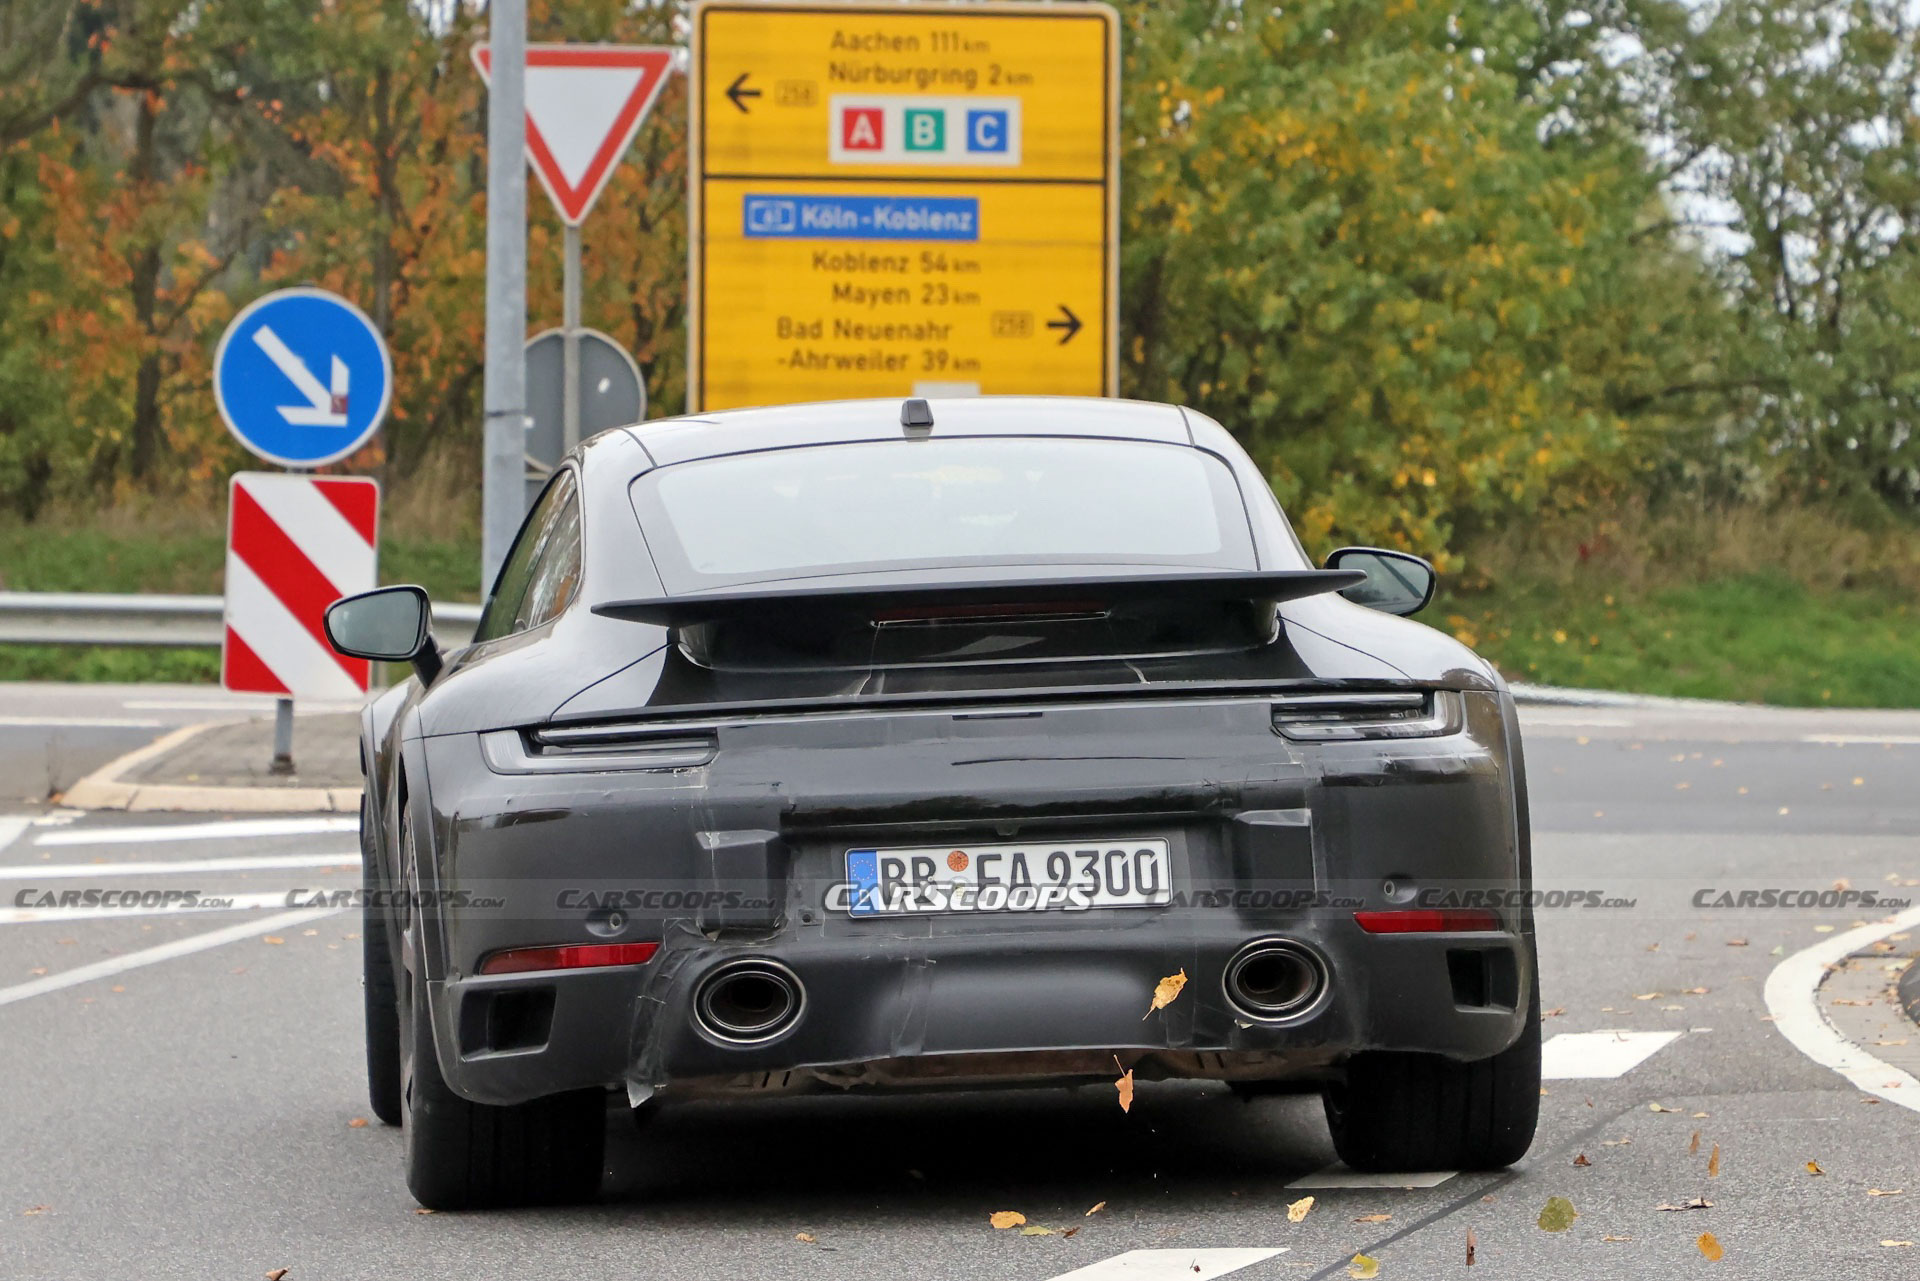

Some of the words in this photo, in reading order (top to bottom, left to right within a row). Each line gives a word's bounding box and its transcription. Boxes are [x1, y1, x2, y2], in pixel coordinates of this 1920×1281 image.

[830, 30, 919, 53] Aachen
[930, 32, 960, 53] 111
[963, 37, 990, 54] km
[829, 62, 978, 90] Nürburgring
[988, 66, 1002, 86] 2
[1005, 72, 1033, 86] km
[849, 116, 876, 146] A
[913, 116, 937, 147] B
[974, 116, 1000, 148] C
[812, 249, 910, 273] Koblenz
[920, 251, 948, 273] 54
[953, 258, 981, 273] km
[832, 284, 911, 308] Mayen
[921, 283, 949, 305] 23
[953, 290, 981, 306] km
[776, 317, 823, 340] Bad
[834, 320, 952, 340] Neuenahr
[778, 349, 908, 372] -Ahrweiler
[921, 350, 949, 372] 39
[954, 357, 981, 372] km
[1046, 849, 1161, 899] 9300
